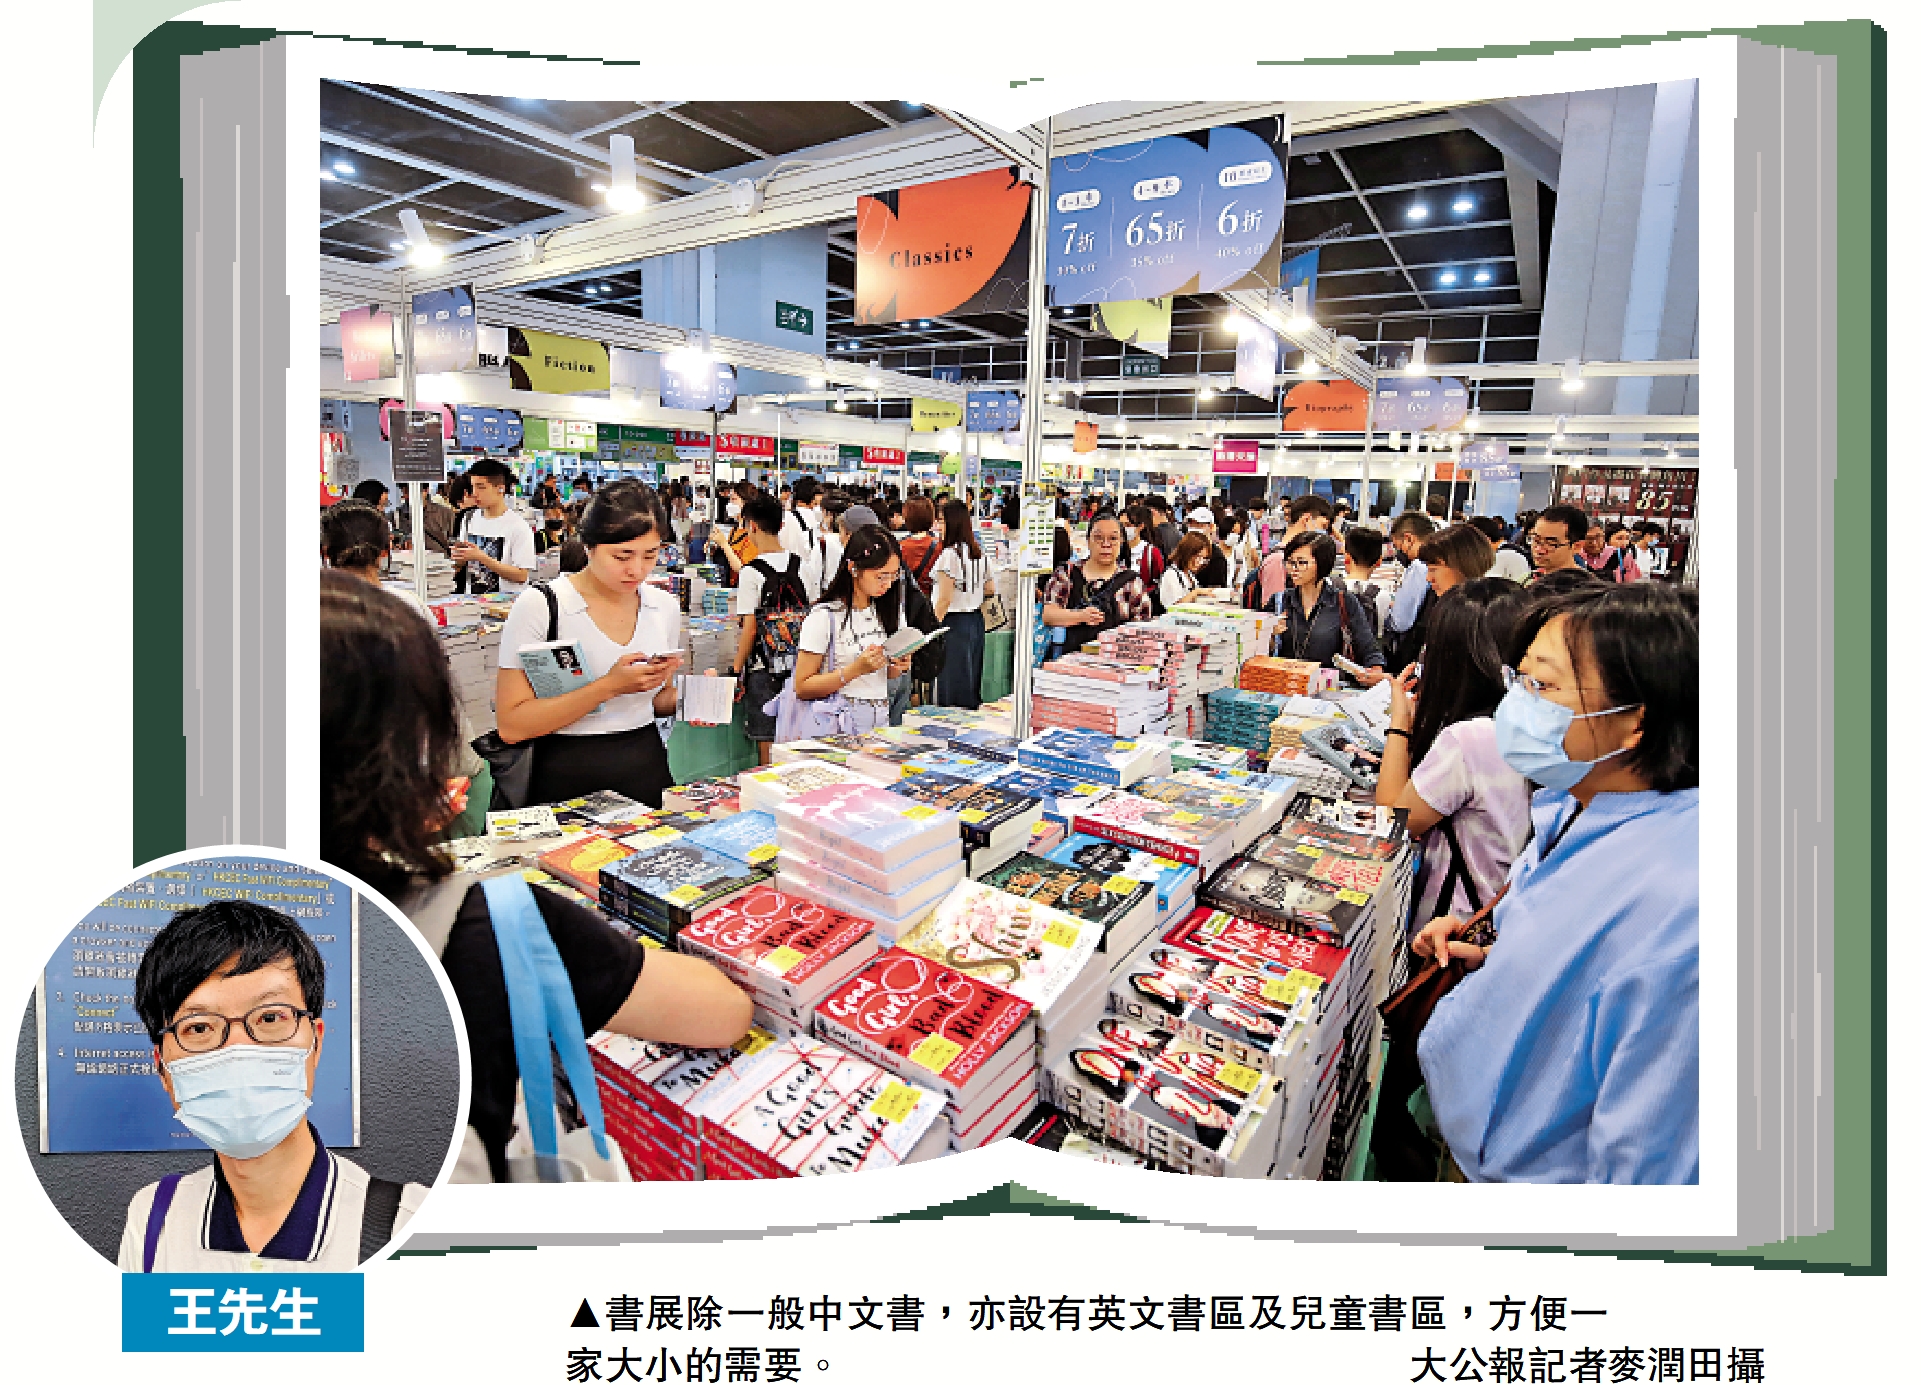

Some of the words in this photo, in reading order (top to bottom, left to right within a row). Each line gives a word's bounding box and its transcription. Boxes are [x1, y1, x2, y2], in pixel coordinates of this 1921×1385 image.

[1061, 222, 1095, 255] 7折
[1126, 210, 1186, 247] 65折
[1218, 200, 1262, 236] 6折
[889, 242, 973, 268] Classics
[544, 355, 596, 373] Fiction
[1635, 491, 1675, 511] 85
[690, 906, 739, 936] Good
[758, 920, 804, 948] Bad
[794, 914, 848, 949] Blood
[945, 902, 1034, 985] Shine
[827, 976, 878, 1017] Good
[909, 996, 957, 1035] Bad
[948, 988, 1004, 1040] Blood
[949, 1043, 988, 1079] HOLLY
[984, 1002, 1029, 1045] JACKSON
[765, 1058, 822, 1105] Good
[778, 1088, 840, 1140] Girl's
[823, 1083, 884, 1136] Guide
